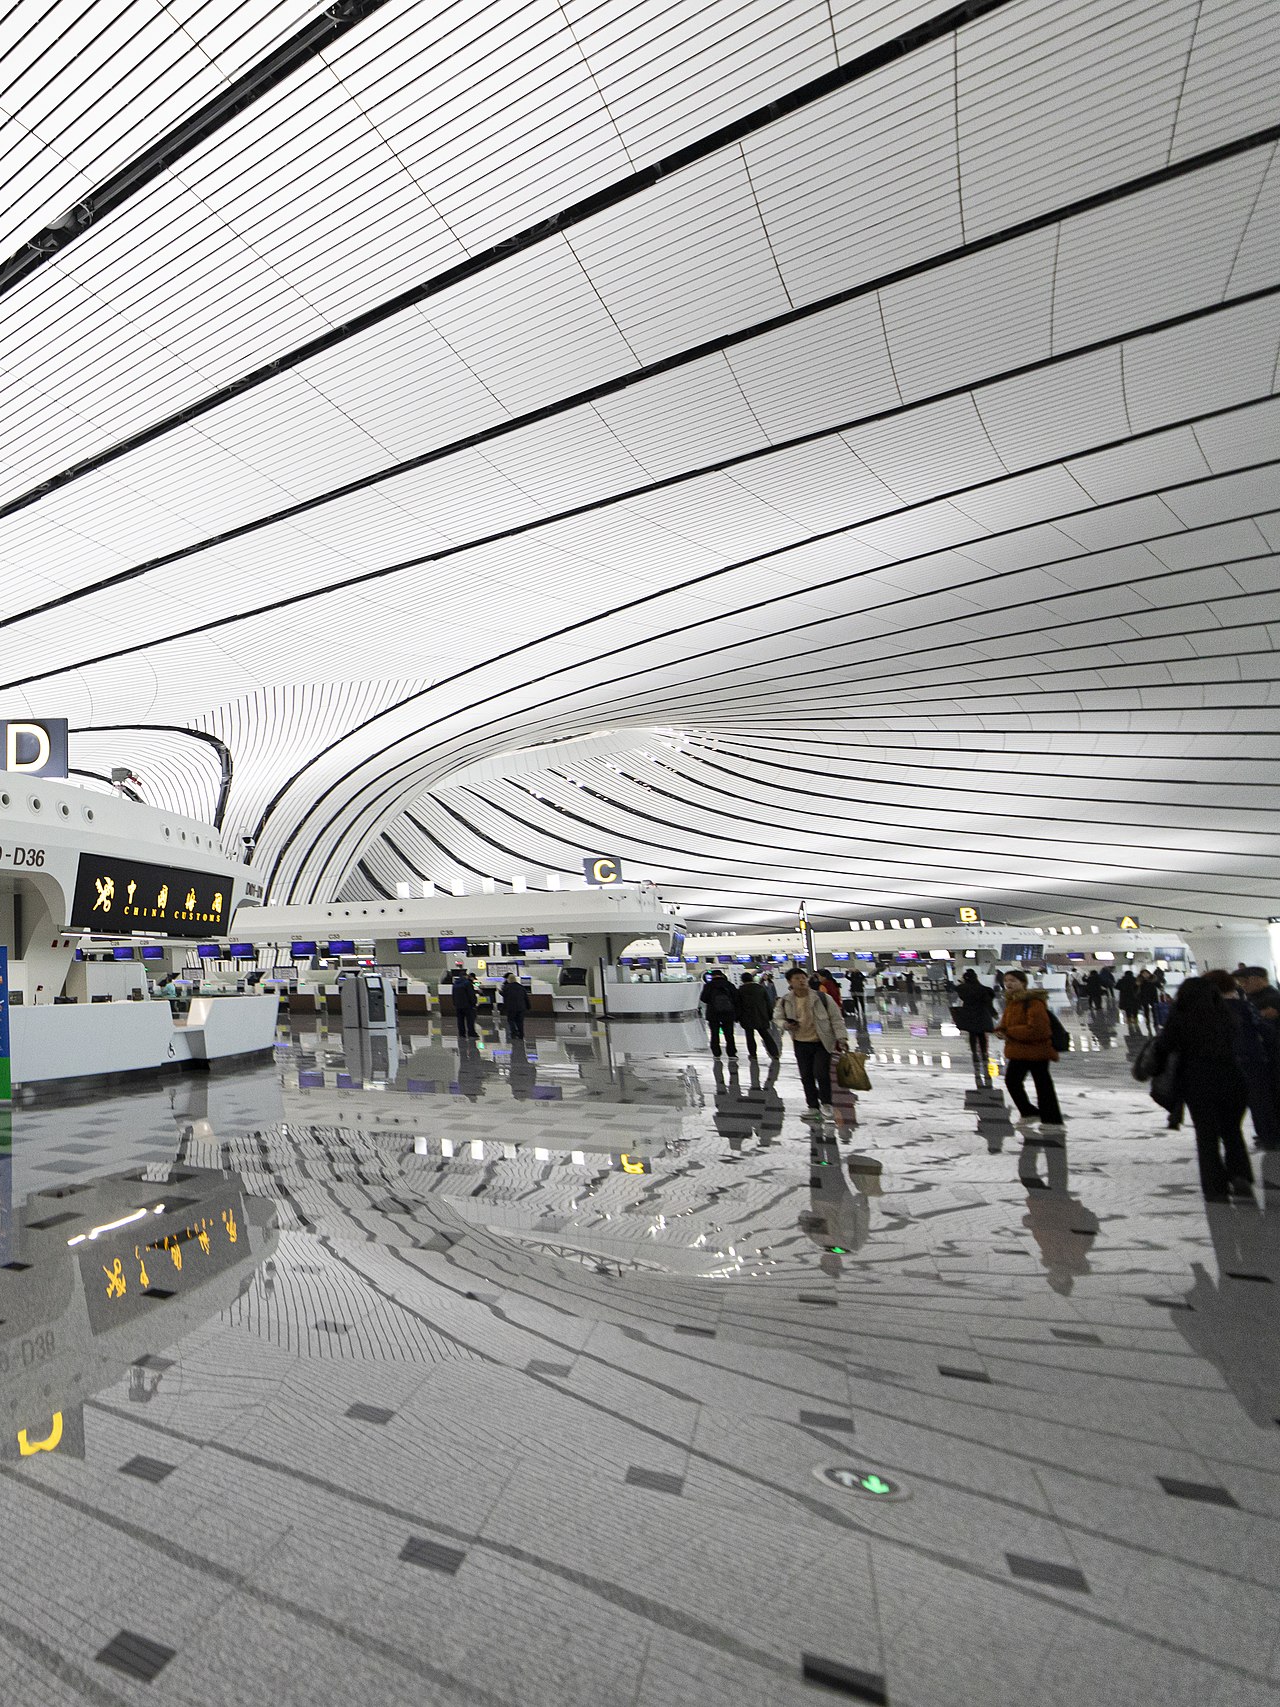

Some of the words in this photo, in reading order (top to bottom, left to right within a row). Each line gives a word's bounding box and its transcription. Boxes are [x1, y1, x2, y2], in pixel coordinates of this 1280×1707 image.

[6, 723, 50, 772] D
[593, 859, 617, 883] C
[124, 906, 166, 918] CHINA
[174, 910, 221, 923] CUSTOMS
[960, 907, 978, 922] B
[1121, 916, 1138, 928] A
